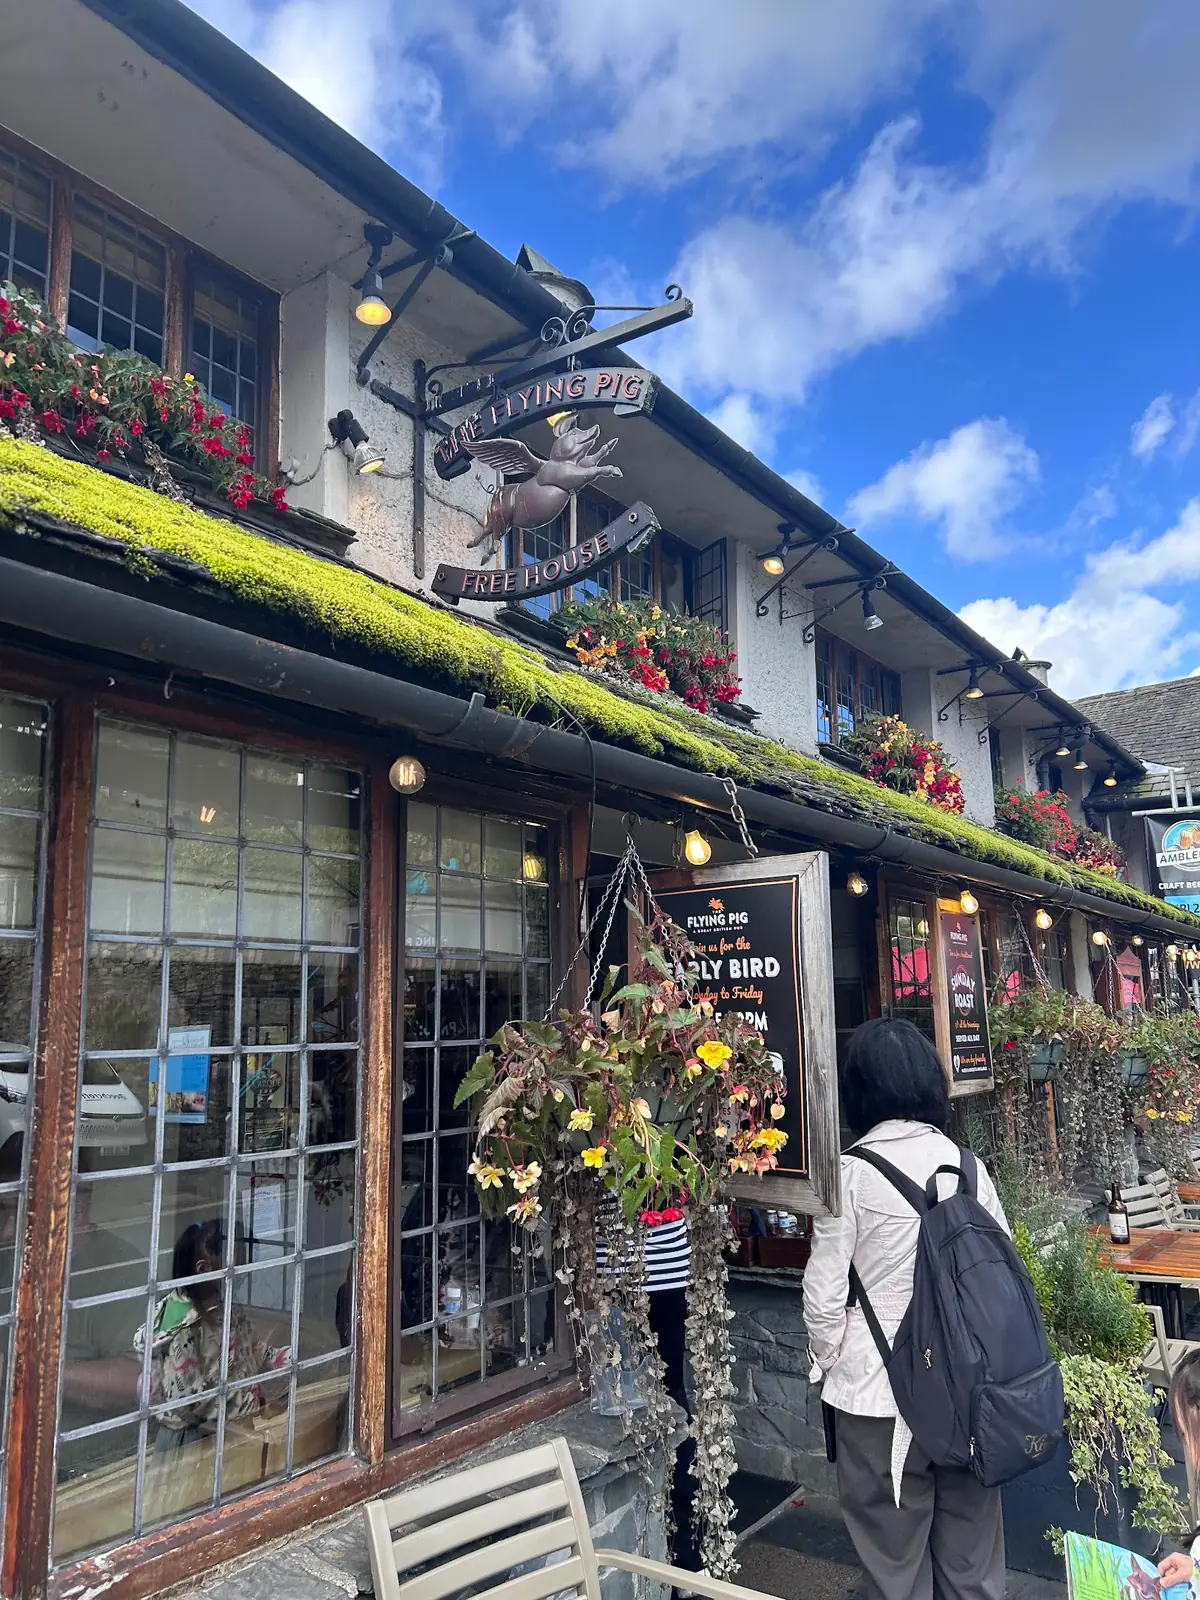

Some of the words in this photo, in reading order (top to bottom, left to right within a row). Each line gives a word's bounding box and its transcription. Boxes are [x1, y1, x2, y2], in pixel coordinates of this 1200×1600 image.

[490, 374, 587, 425] FLYING
[594, 373, 644, 399] PIG
[461, 571, 517, 594] FREE
[524, 531, 611, 588] HOUSE
[1158, 882, 1185, 890] CRAFT
[687, 913, 726, 928] FLYING
[728, 911, 749, 924] PIG
[695, 942, 706, 952] in
[708, 944, 718, 952] us
[719, 937, 734, 956] for
[735, 935, 751, 951] the
[666, 960, 723, 980] RLY
[729, 956, 781, 979] BIRD
[951, 972, 976, 992] SUNDAY
[720, 986, 730, 999] to
[731, 984, 763, 1005] Friday
[954, 993, 975, 1009] ROAST
